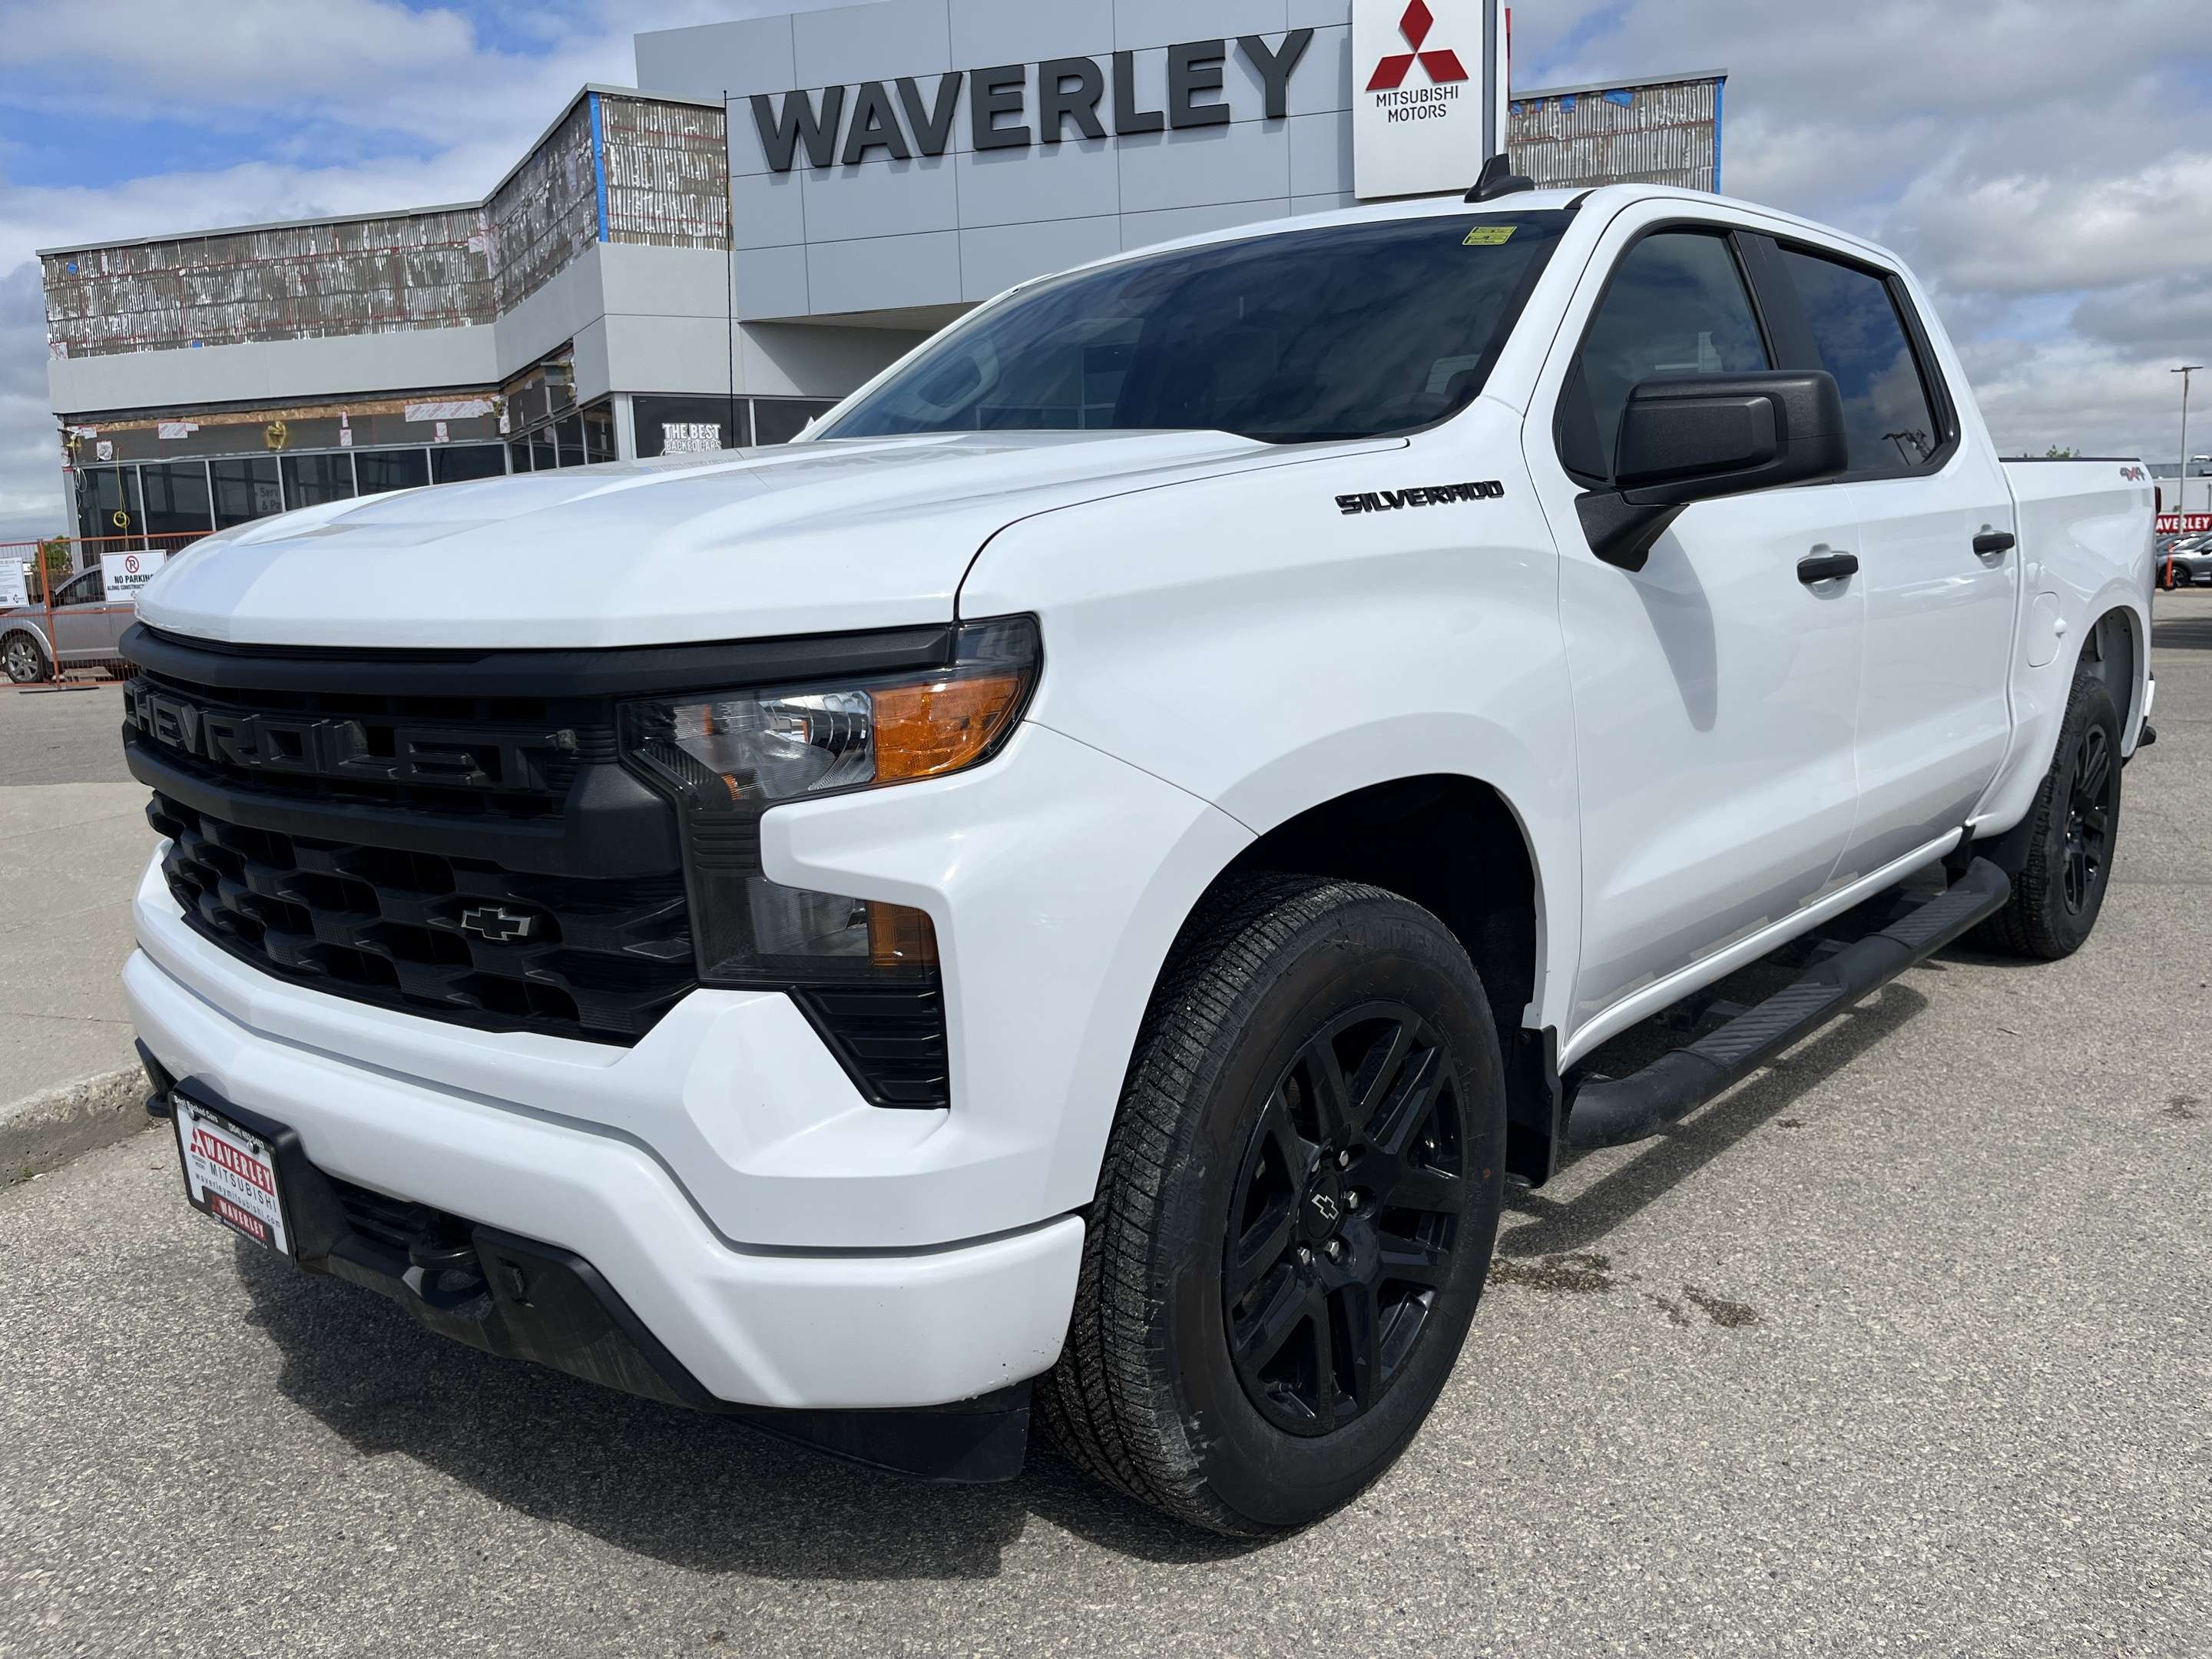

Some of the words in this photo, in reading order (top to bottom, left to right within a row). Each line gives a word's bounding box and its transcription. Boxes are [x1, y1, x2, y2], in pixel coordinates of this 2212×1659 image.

[750, 28, 1315, 172] WAVERLEY
[1376, 85, 1459, 108] MITSUBISHI
[1388, 104, 1447, 123] MOTORS
[664, 423, 688, 439] THE
[690, 423, 720, 439] BEST
[666, 440, 697, 452] BACKED
[700, 440, 722, 452] CARS
[1335, 480, 1505, 515] SILVERADO
[2155, 517, 2210, 530] AVERLEY
[114, 575, 124, 584] NO
[124, 574, 154, 584] PARKIN
[204, 1134, 273, 1192] WAVERLEY
[196, 1173, 280, 1228] waverleymitsubishi.com
[210, 1161, 276, 1213] MITSUBISHI
[220, 1199, 264, 1238] WAVERLEY
